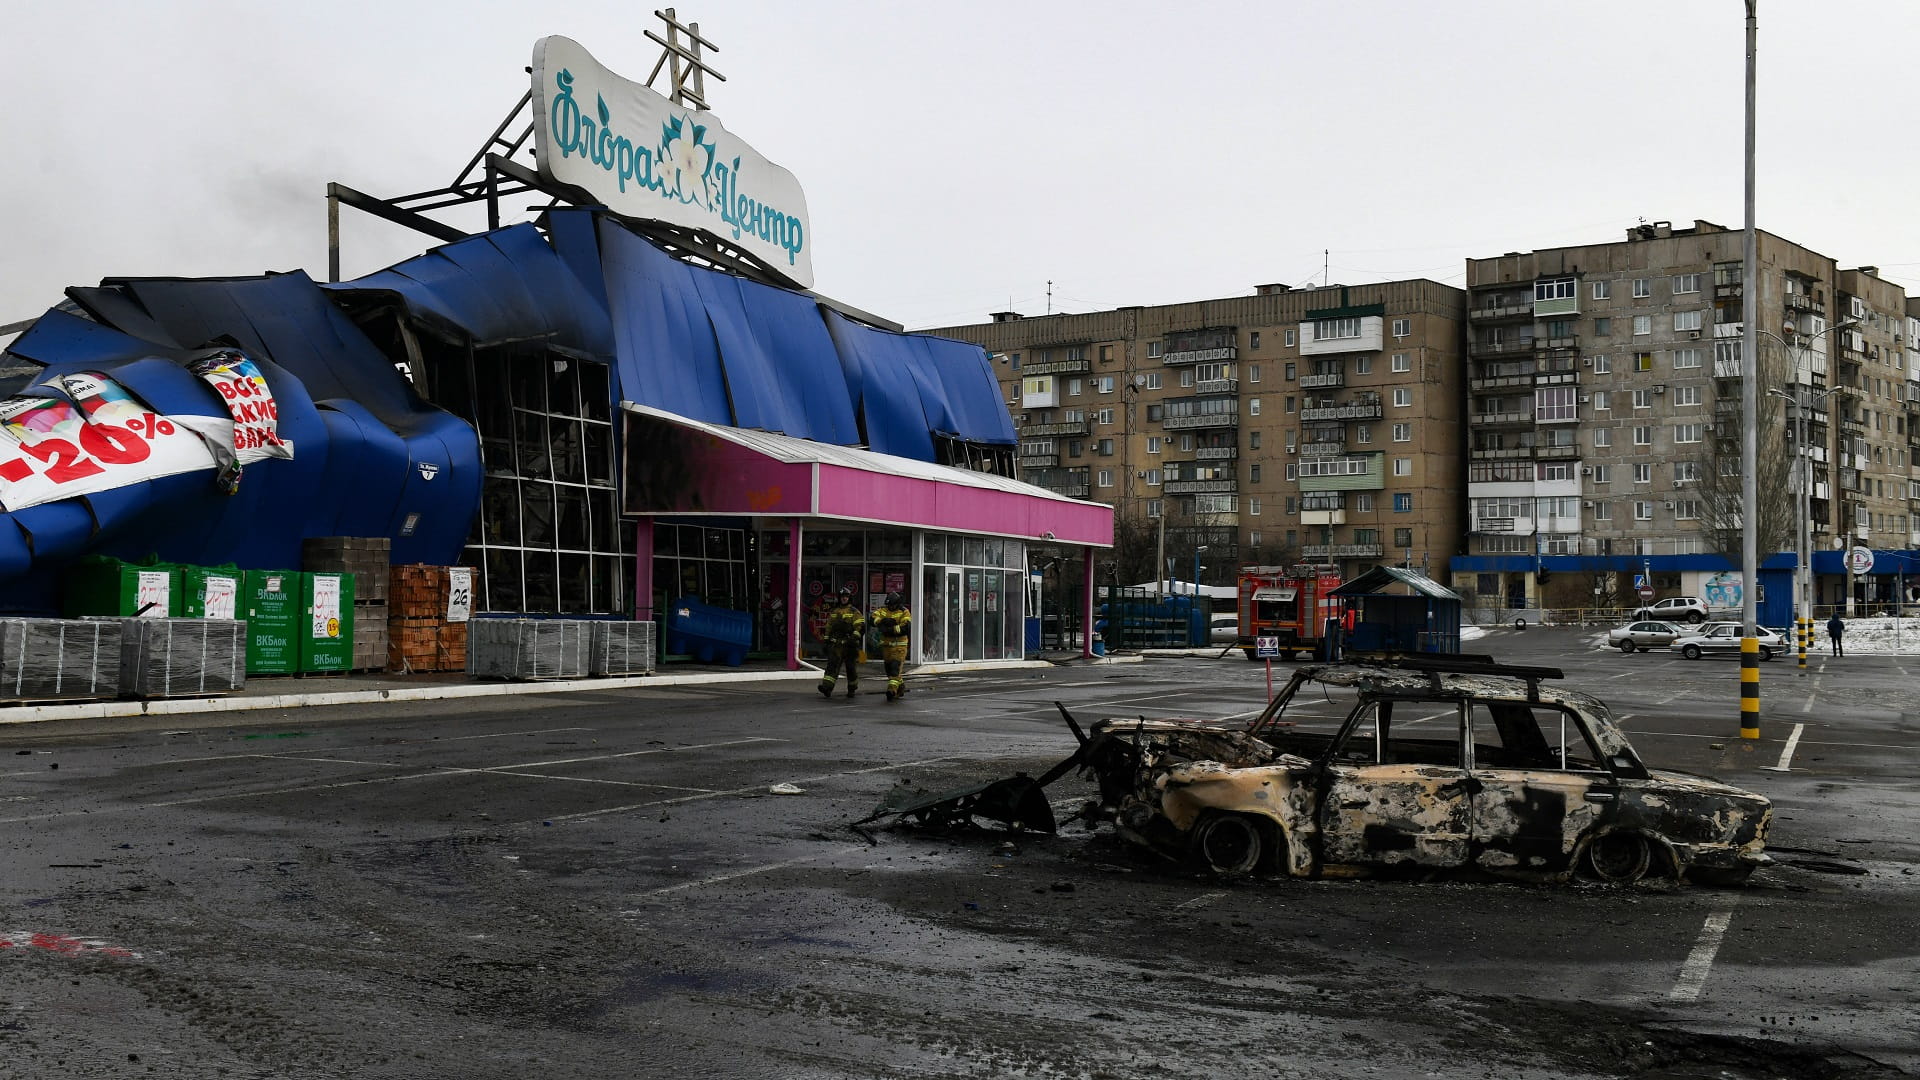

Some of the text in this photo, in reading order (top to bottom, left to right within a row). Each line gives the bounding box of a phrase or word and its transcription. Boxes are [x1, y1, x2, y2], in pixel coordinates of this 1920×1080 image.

[551, 68, 803, 265] Флора Центр
[453, 588, 468, 605] 26
